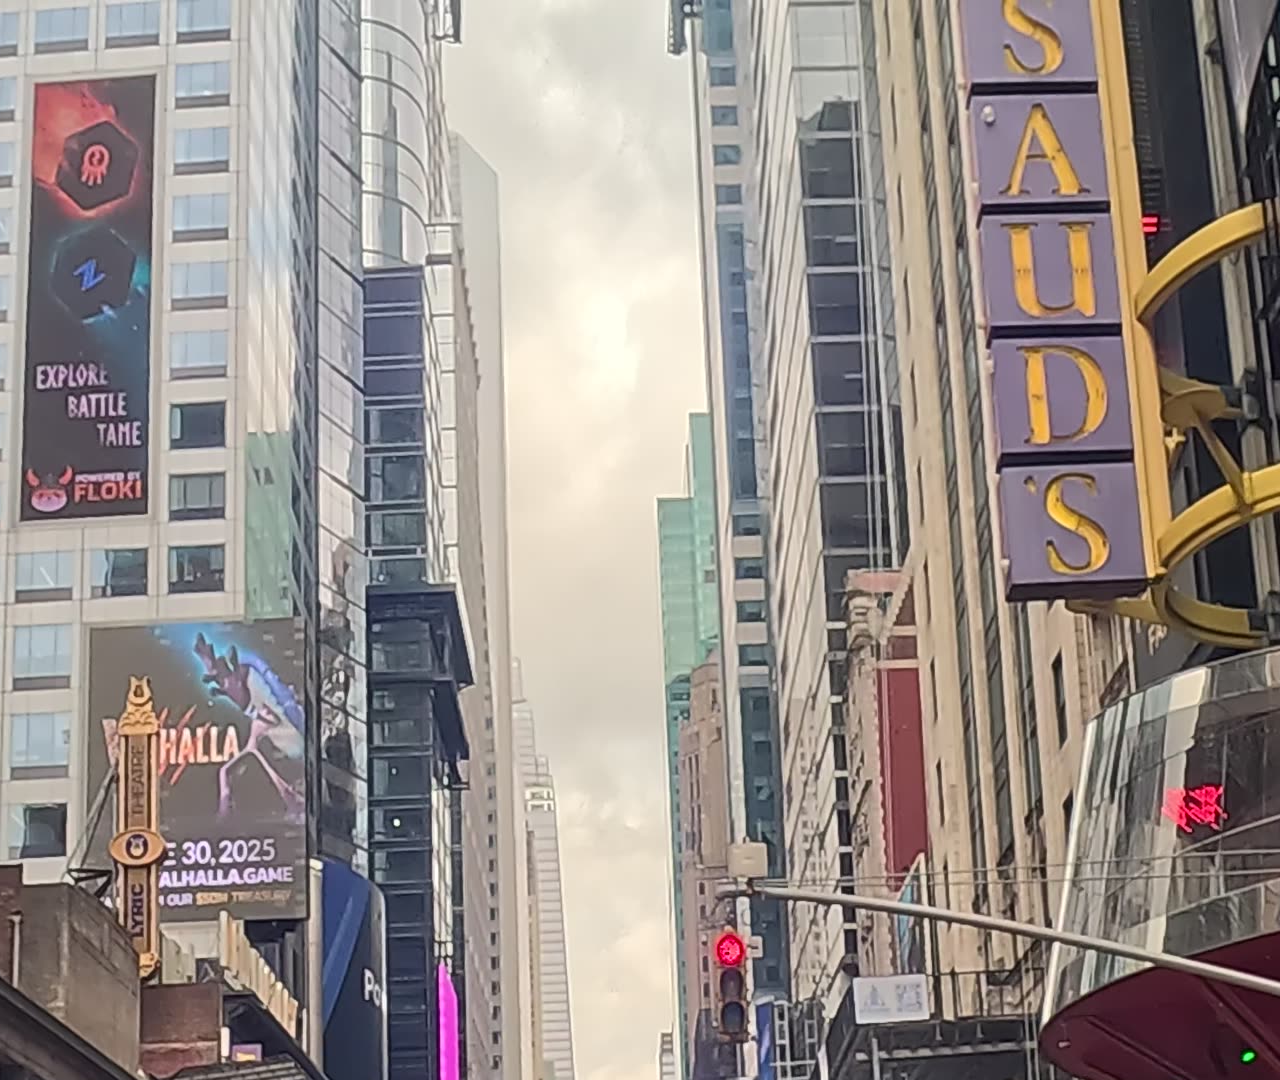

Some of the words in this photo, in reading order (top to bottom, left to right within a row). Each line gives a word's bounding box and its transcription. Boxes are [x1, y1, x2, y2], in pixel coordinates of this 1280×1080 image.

[36, 364, 109, 389] EXPLORE
[67, 392, 127, 418] BATTLE
[96, 421, 142, 446] TAME
[74, 481, 142, 503] FLOKI
[102, 718, 239, 766] VHALLA
[128, 745, 144, 819] THEATRE
[182, 840, 217, 866] 30,
[218, 839, 276, 864] 2025
[158, 866, 295, 889] ALHALLA.GAME
[129, 883, 144, 938] LYRIC
